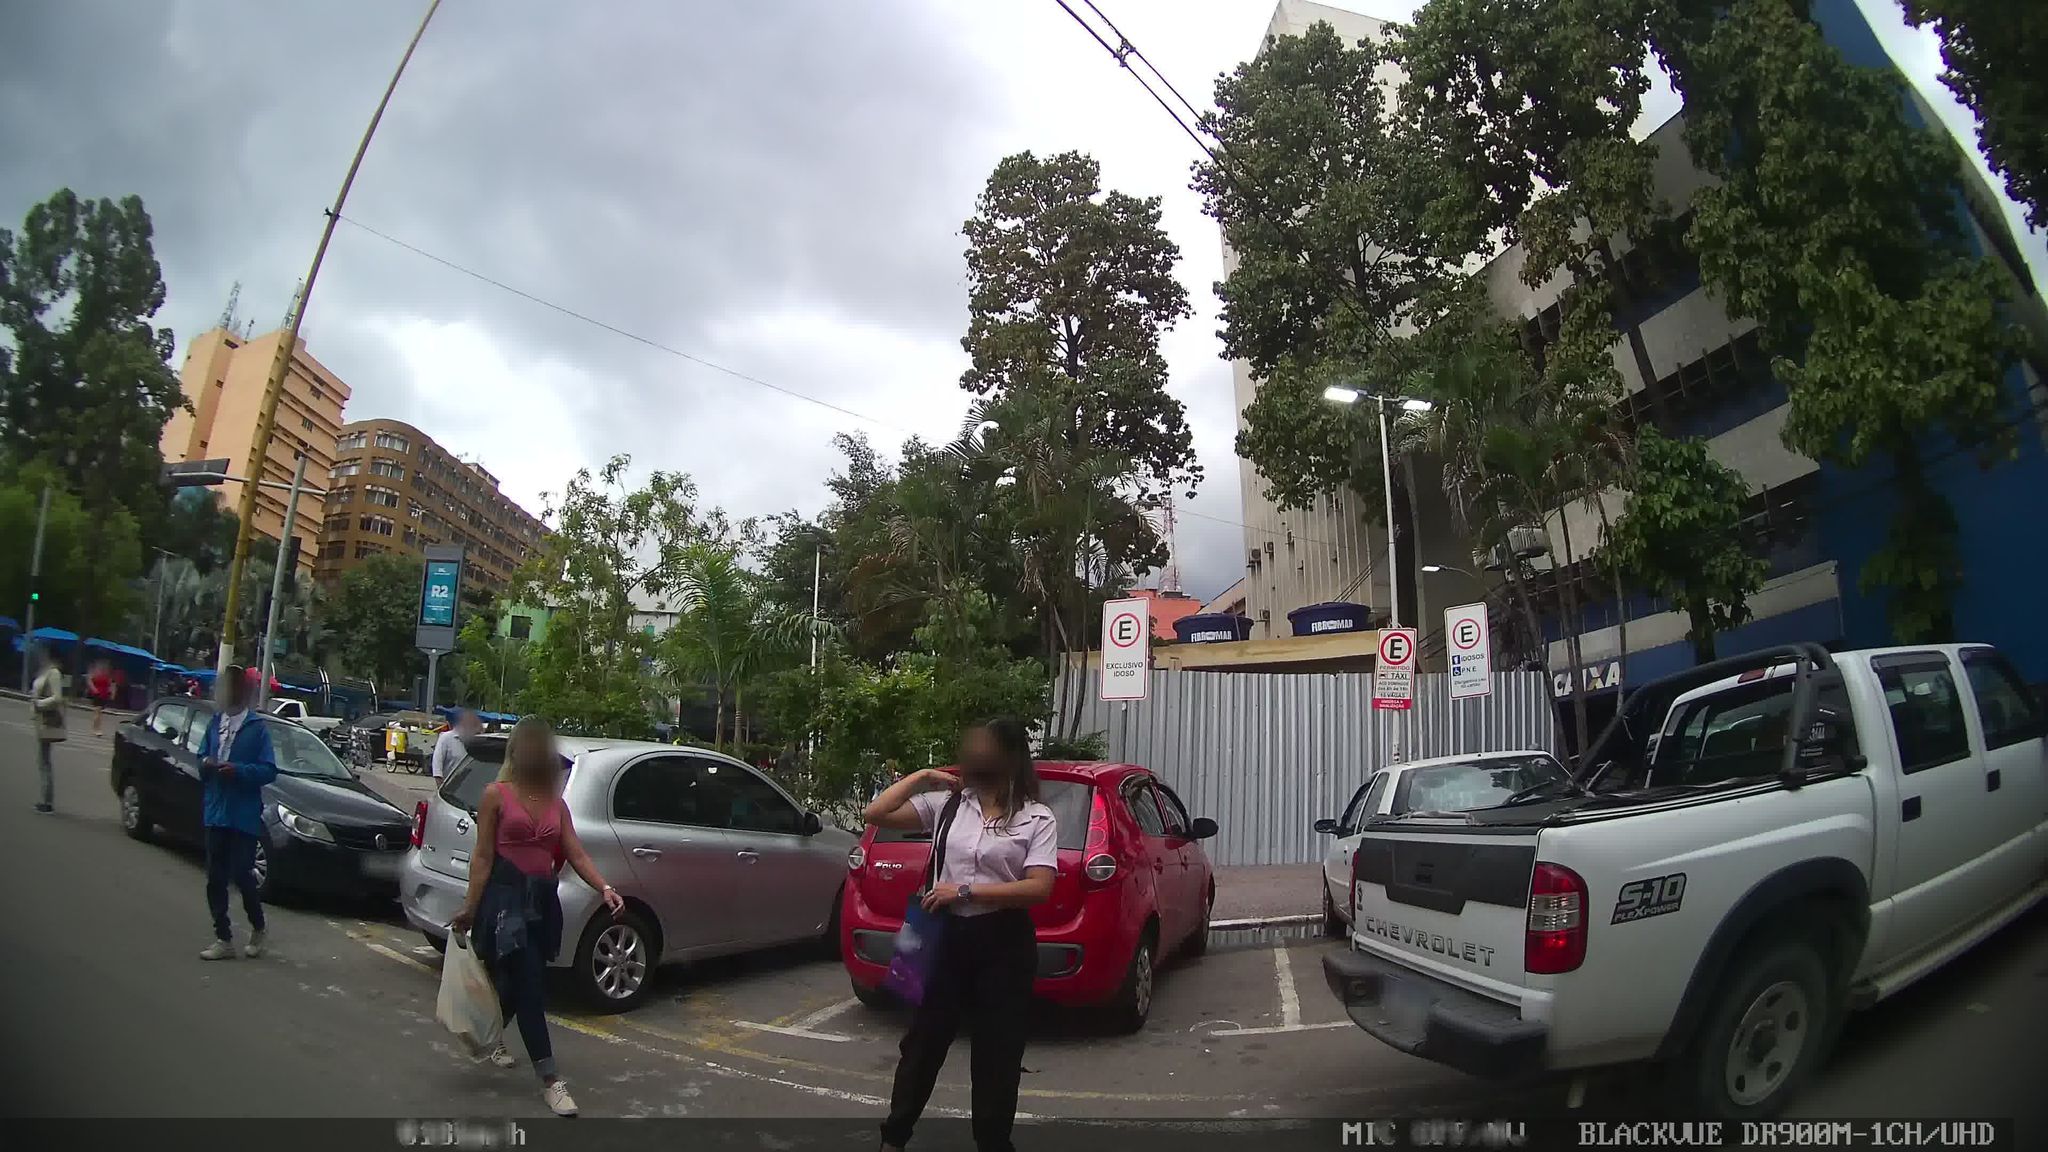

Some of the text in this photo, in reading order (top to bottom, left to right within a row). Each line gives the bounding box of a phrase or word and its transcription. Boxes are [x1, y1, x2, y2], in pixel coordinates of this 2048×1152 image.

[431, 584, 449, 599] R2
[1118, 620, 1132, 640] E
[1460, 625, 1473, 643] E
[1389, 638, 1402, 659] E
[1461, 653, 1485, 662] IDOSOS
[1105, 661, 1144, 670] EXCLUSIVO
[1554, 661, 1620, 698] CAIXA
[1617, 873, 1685, 910] S-10
[1366, 916, 1495, 967] CHEVROLET
